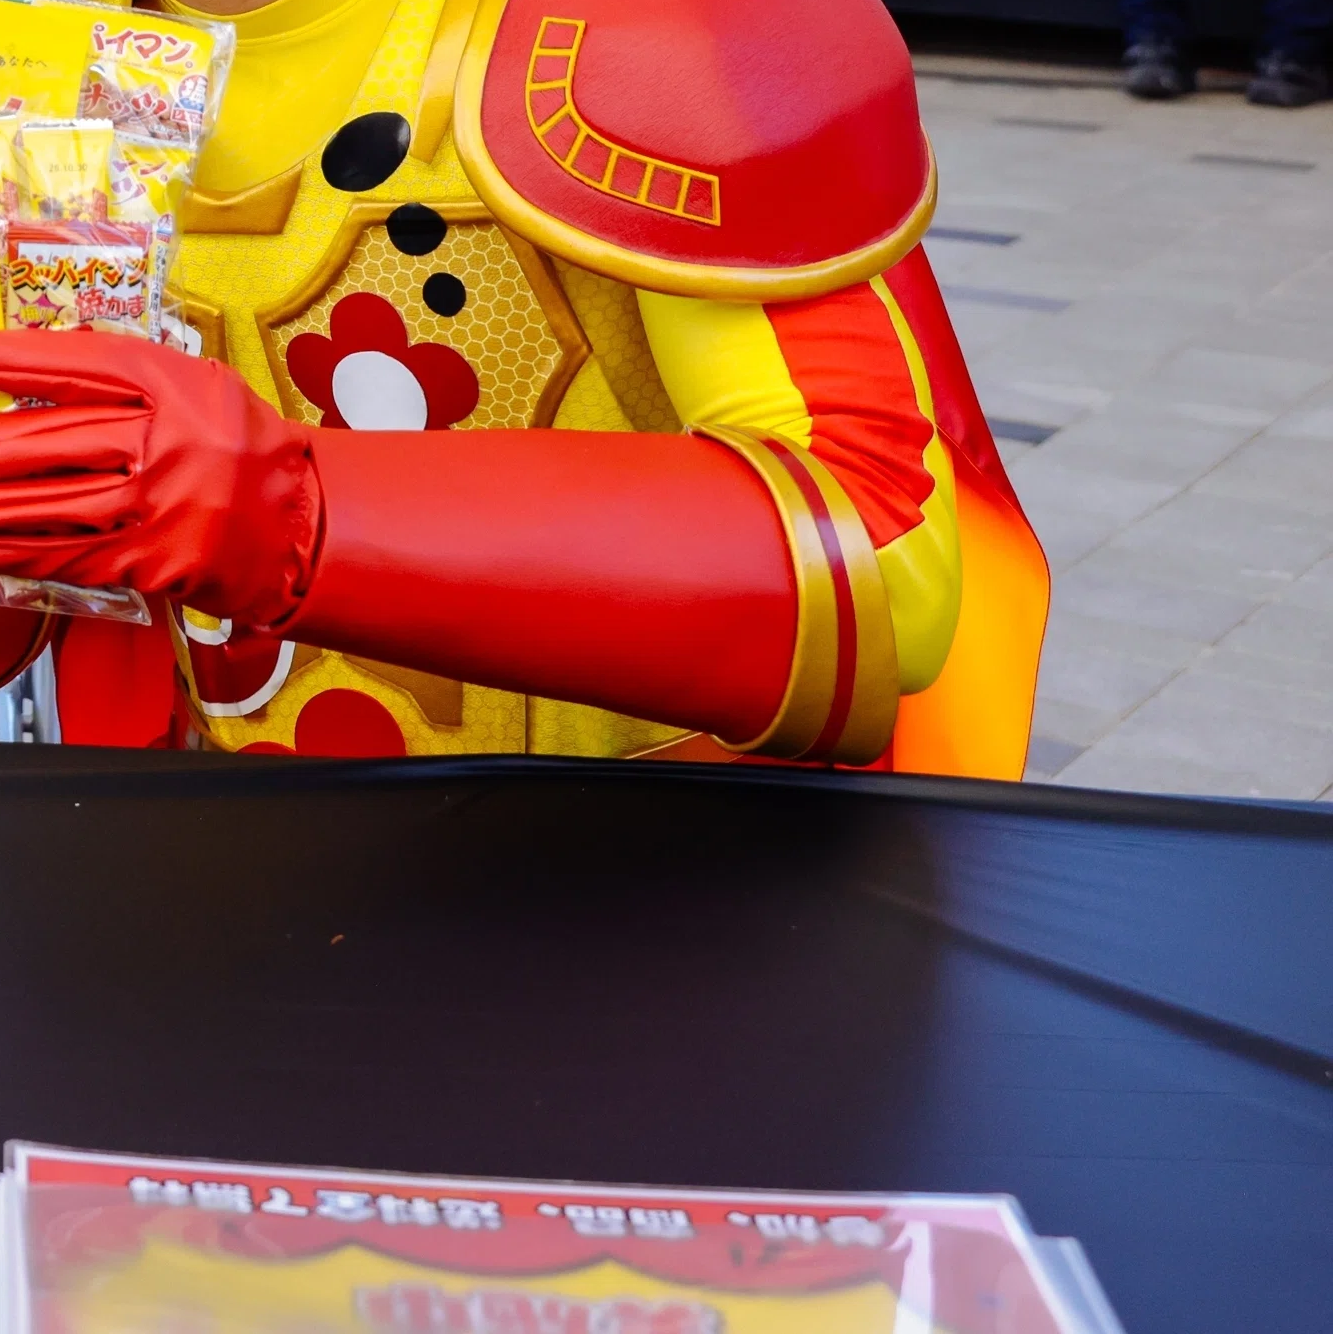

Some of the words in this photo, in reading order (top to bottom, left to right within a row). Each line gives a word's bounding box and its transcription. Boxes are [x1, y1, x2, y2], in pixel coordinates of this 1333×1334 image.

[11, 257, 149, 290] スッパイマン
